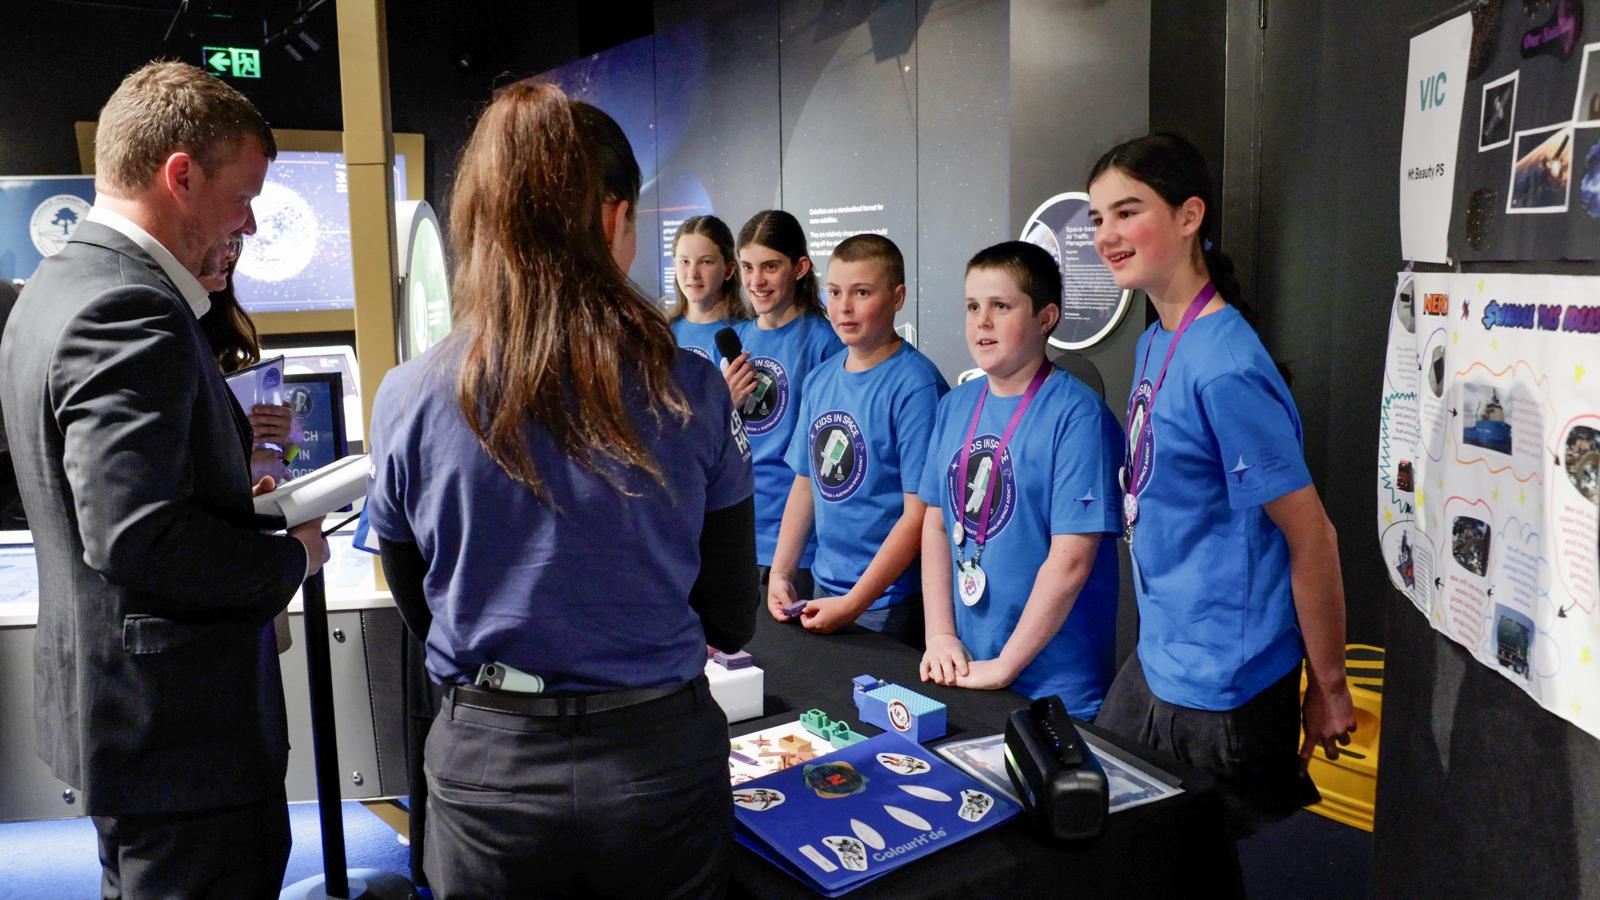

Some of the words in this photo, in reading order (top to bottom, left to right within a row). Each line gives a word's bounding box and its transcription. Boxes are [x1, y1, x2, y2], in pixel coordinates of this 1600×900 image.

[1420, 71, 1447, 112] VIC
[1407, 167, 1415, 181] Mt
[1415, 166, 1435, 181] Beauty
[1435, 163, 1445, 177] PS
[1073, 232, 1089, 240] Traffic
[755, 359, 763, 367] IN
[764, 360, 784, 377] SPACE
[814, 414, 832, 431] KIDS
[833, 413, 842, 423] IN
[842, 414, 860, 438] SPACE
